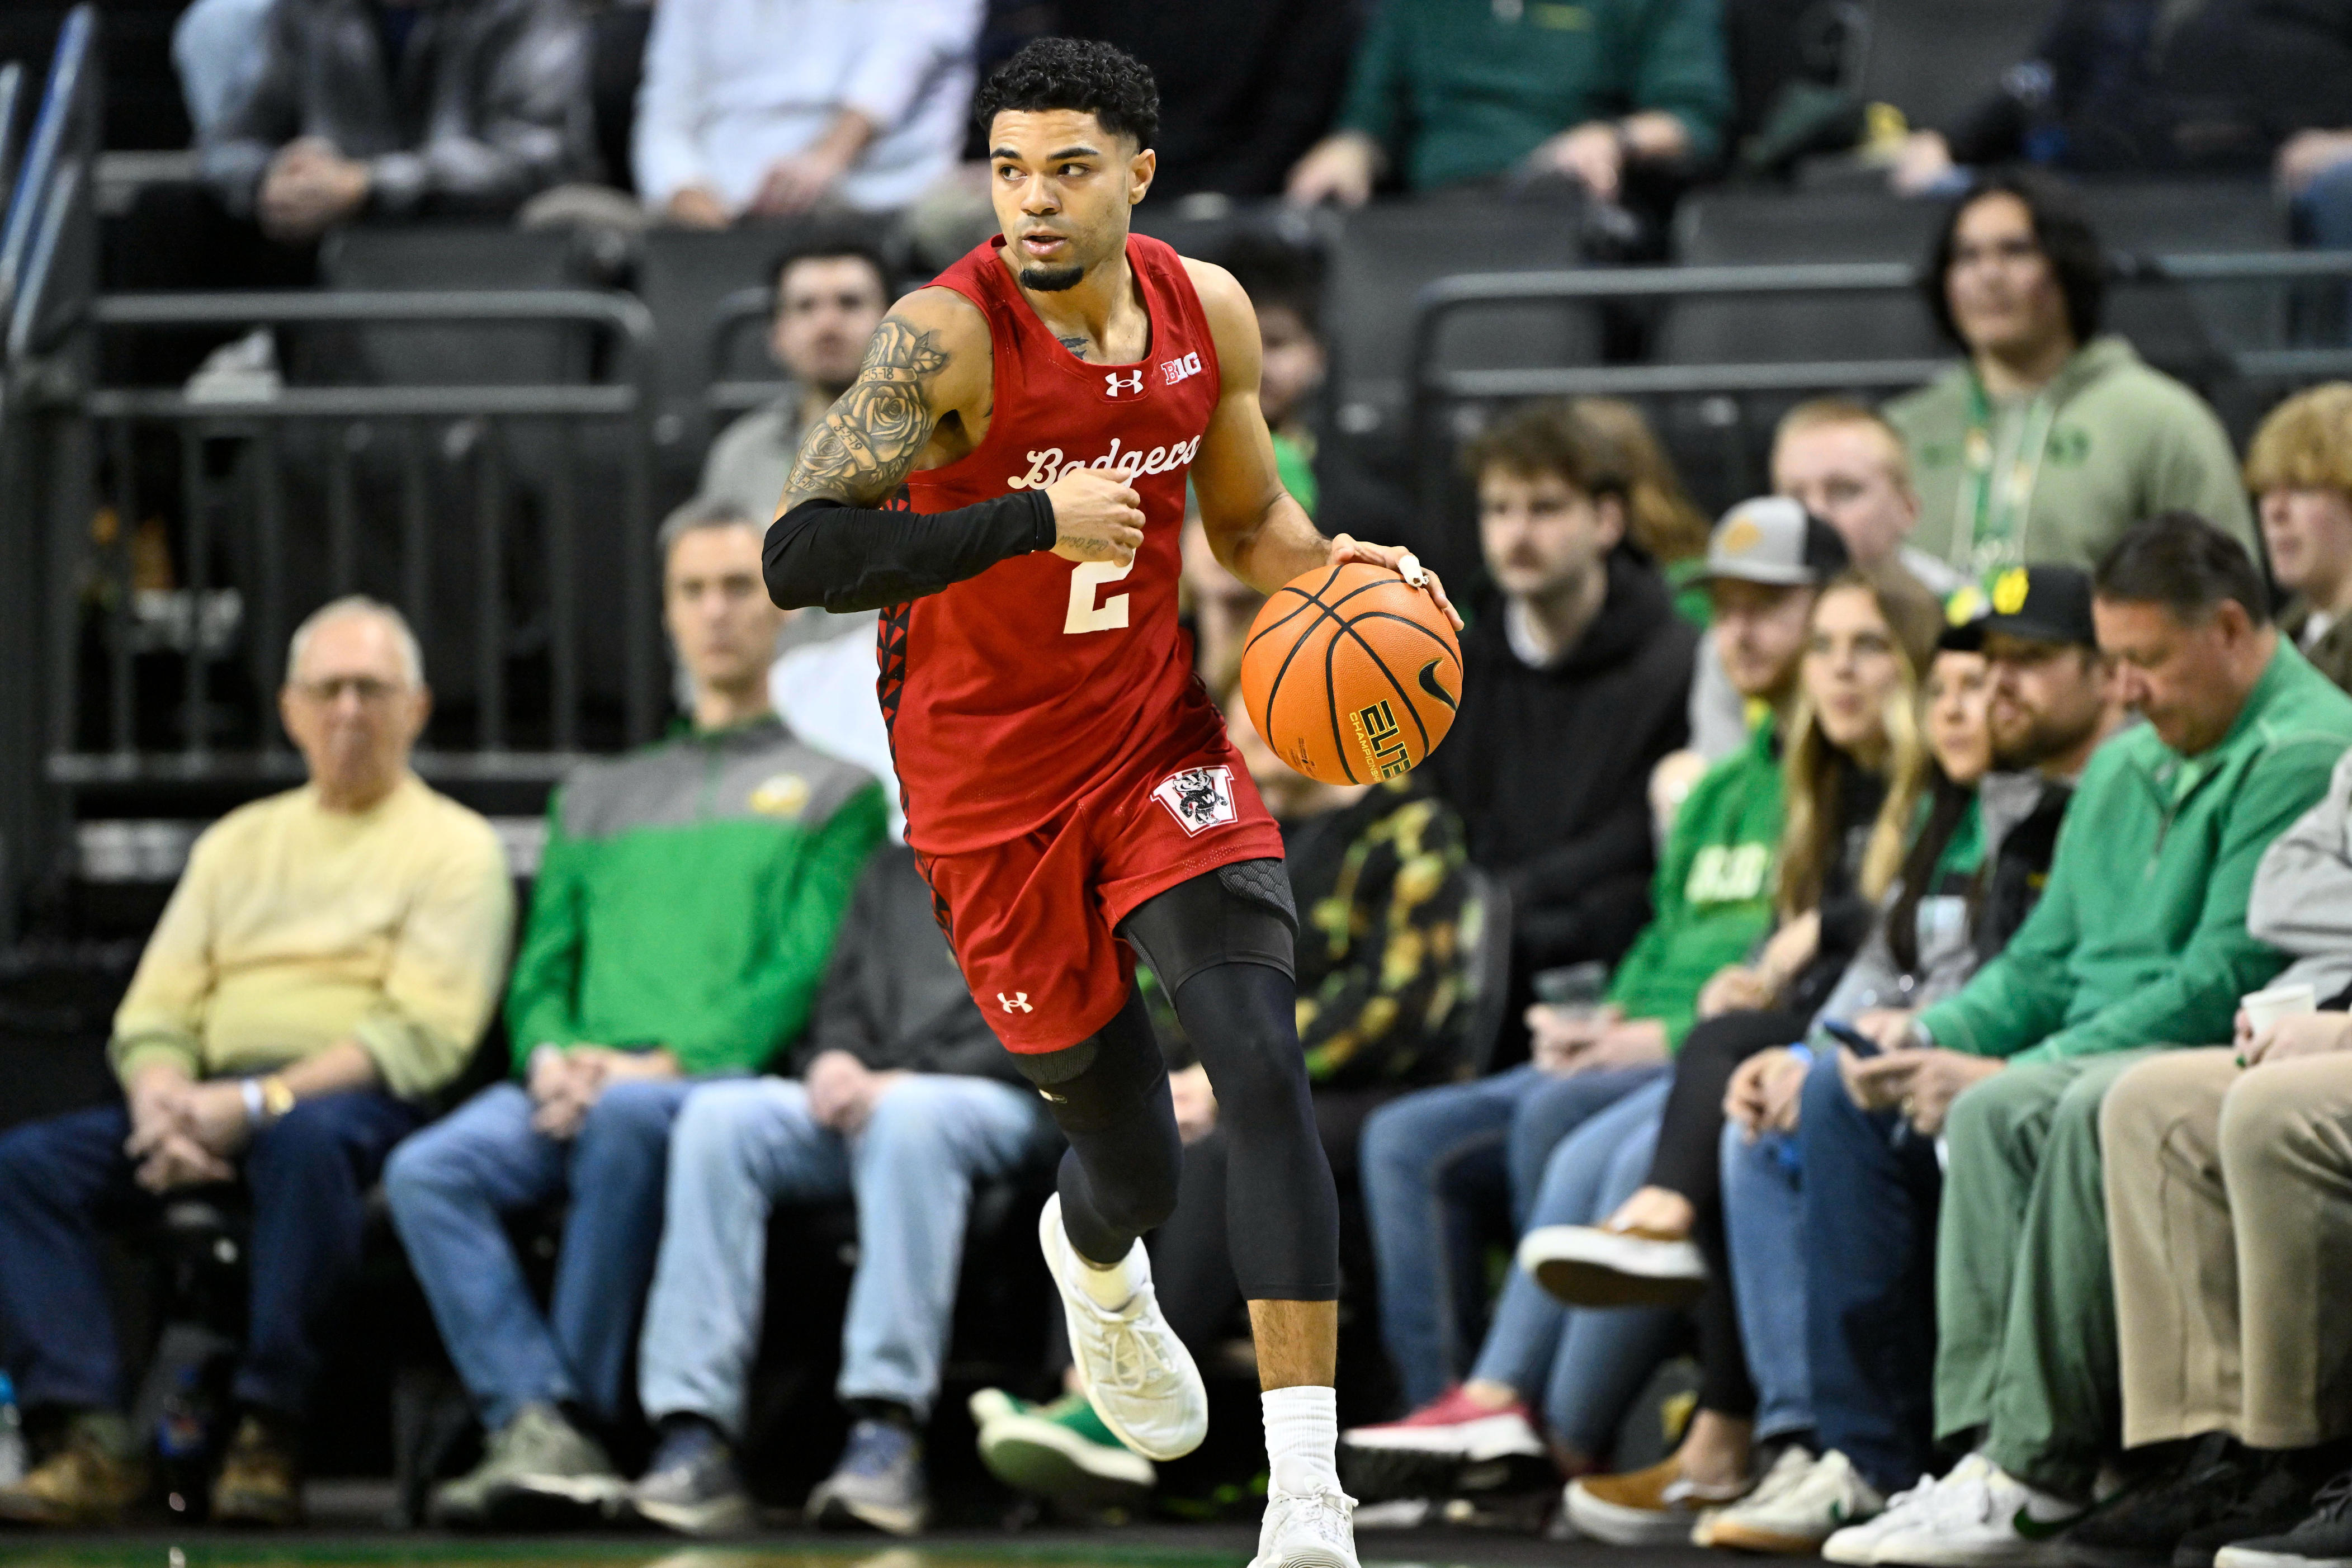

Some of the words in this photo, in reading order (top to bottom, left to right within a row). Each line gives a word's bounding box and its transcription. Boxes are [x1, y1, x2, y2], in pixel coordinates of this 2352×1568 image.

[834, 423, 862, 450] 3-2-19
[1007, 434, 1201, 490] Badgers
[1063, 547, 1137, 634] 2
[1358, 698, 1411, 780] ELITE
